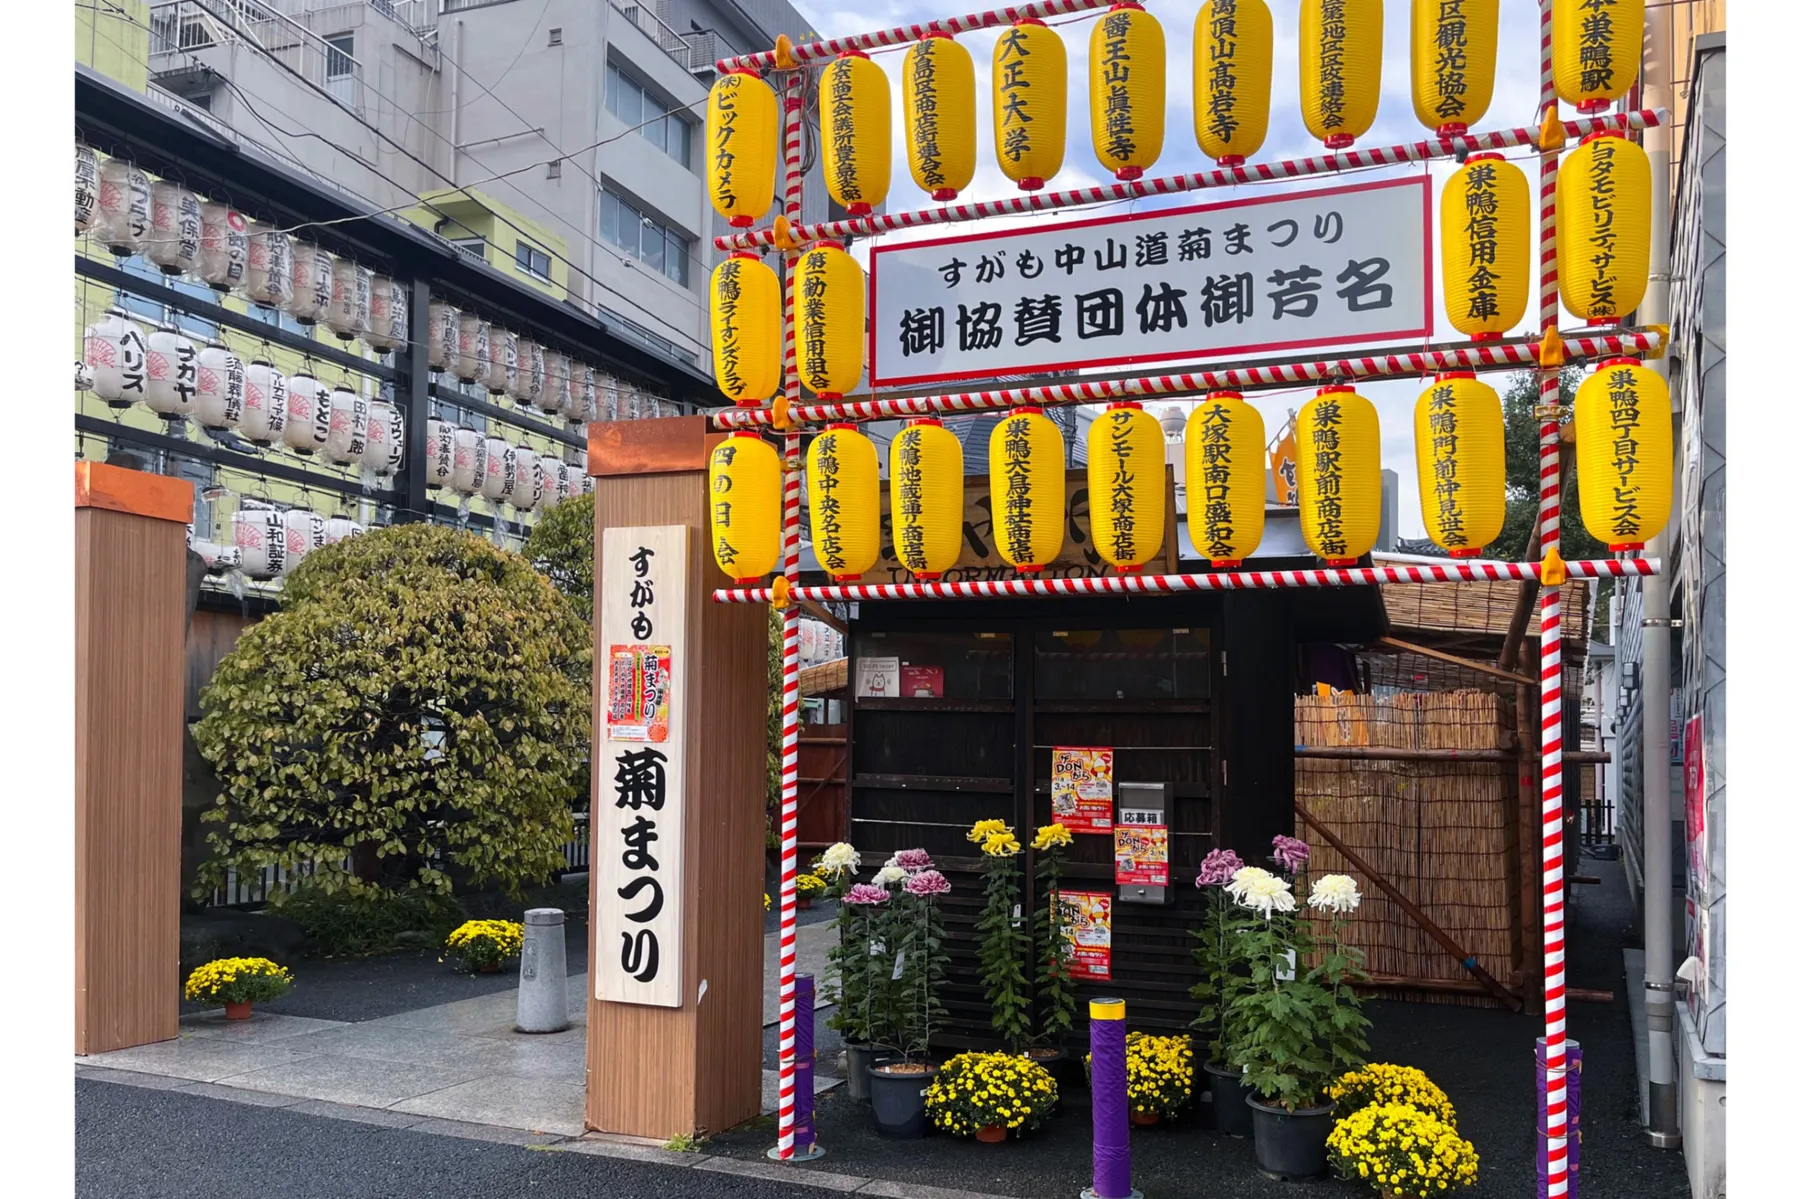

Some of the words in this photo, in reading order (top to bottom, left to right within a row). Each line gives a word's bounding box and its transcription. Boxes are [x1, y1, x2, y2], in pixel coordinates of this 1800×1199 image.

[830, 58, 862, 202] 東京商工会議所豊島支部
[912, 39, 945, 187] 豊島区商店街連合会
[999, 28, 1033, 162] 大正大学
[900, 257, 1393, 357] 御協賛団体御芳名
[938, 210, 1344, 289] すがも中山道菊まつり
[1464, 163, 1501, 322] 巣鴨信用金庫
[120, 331, 146, 394] ハリス
[225, 356, 245, 421] 須藤葬儀社
[718, 260, 747, 396] 巣鴨ライオンズクラブ
[803, 252, 830, 389] 第一勧業信用組合
[348, 401, 367, 455] 田村一郎
[1004, 418, 1035, 564] 巣鴨大鳥神社商店街
[1111, 411, 1136, 561] サンモール大塚商店街
[1200, 404, 1236, 558] 大塚駅南口盛和会
[1312, 400, 1348, 556] 巣鴨駅前商店街
[1429, 384, 1469, 547] 巣鴨門前仲見世会
[1607, 368, 1641, 536] 巣鴨四丁目サービス会
[266, 514, 284, 573] 山和証券
[713, 446, 739, 566] 四の日会
[817, 434, 847, 570] 巣鴨中央名店会
[898, 429, 928, 570] 巣鴨地蔵通り商店街
[628, 546, 655, 642] すがも
[644, 655, 658, 718] 菊まつり
[1056, 762, 1082, 773] DON
[1124, 812, 1158, 824] 応募箱
[614, 747, 669, 983] 菊まつり
[1118, 838, 1140, 846] DON
